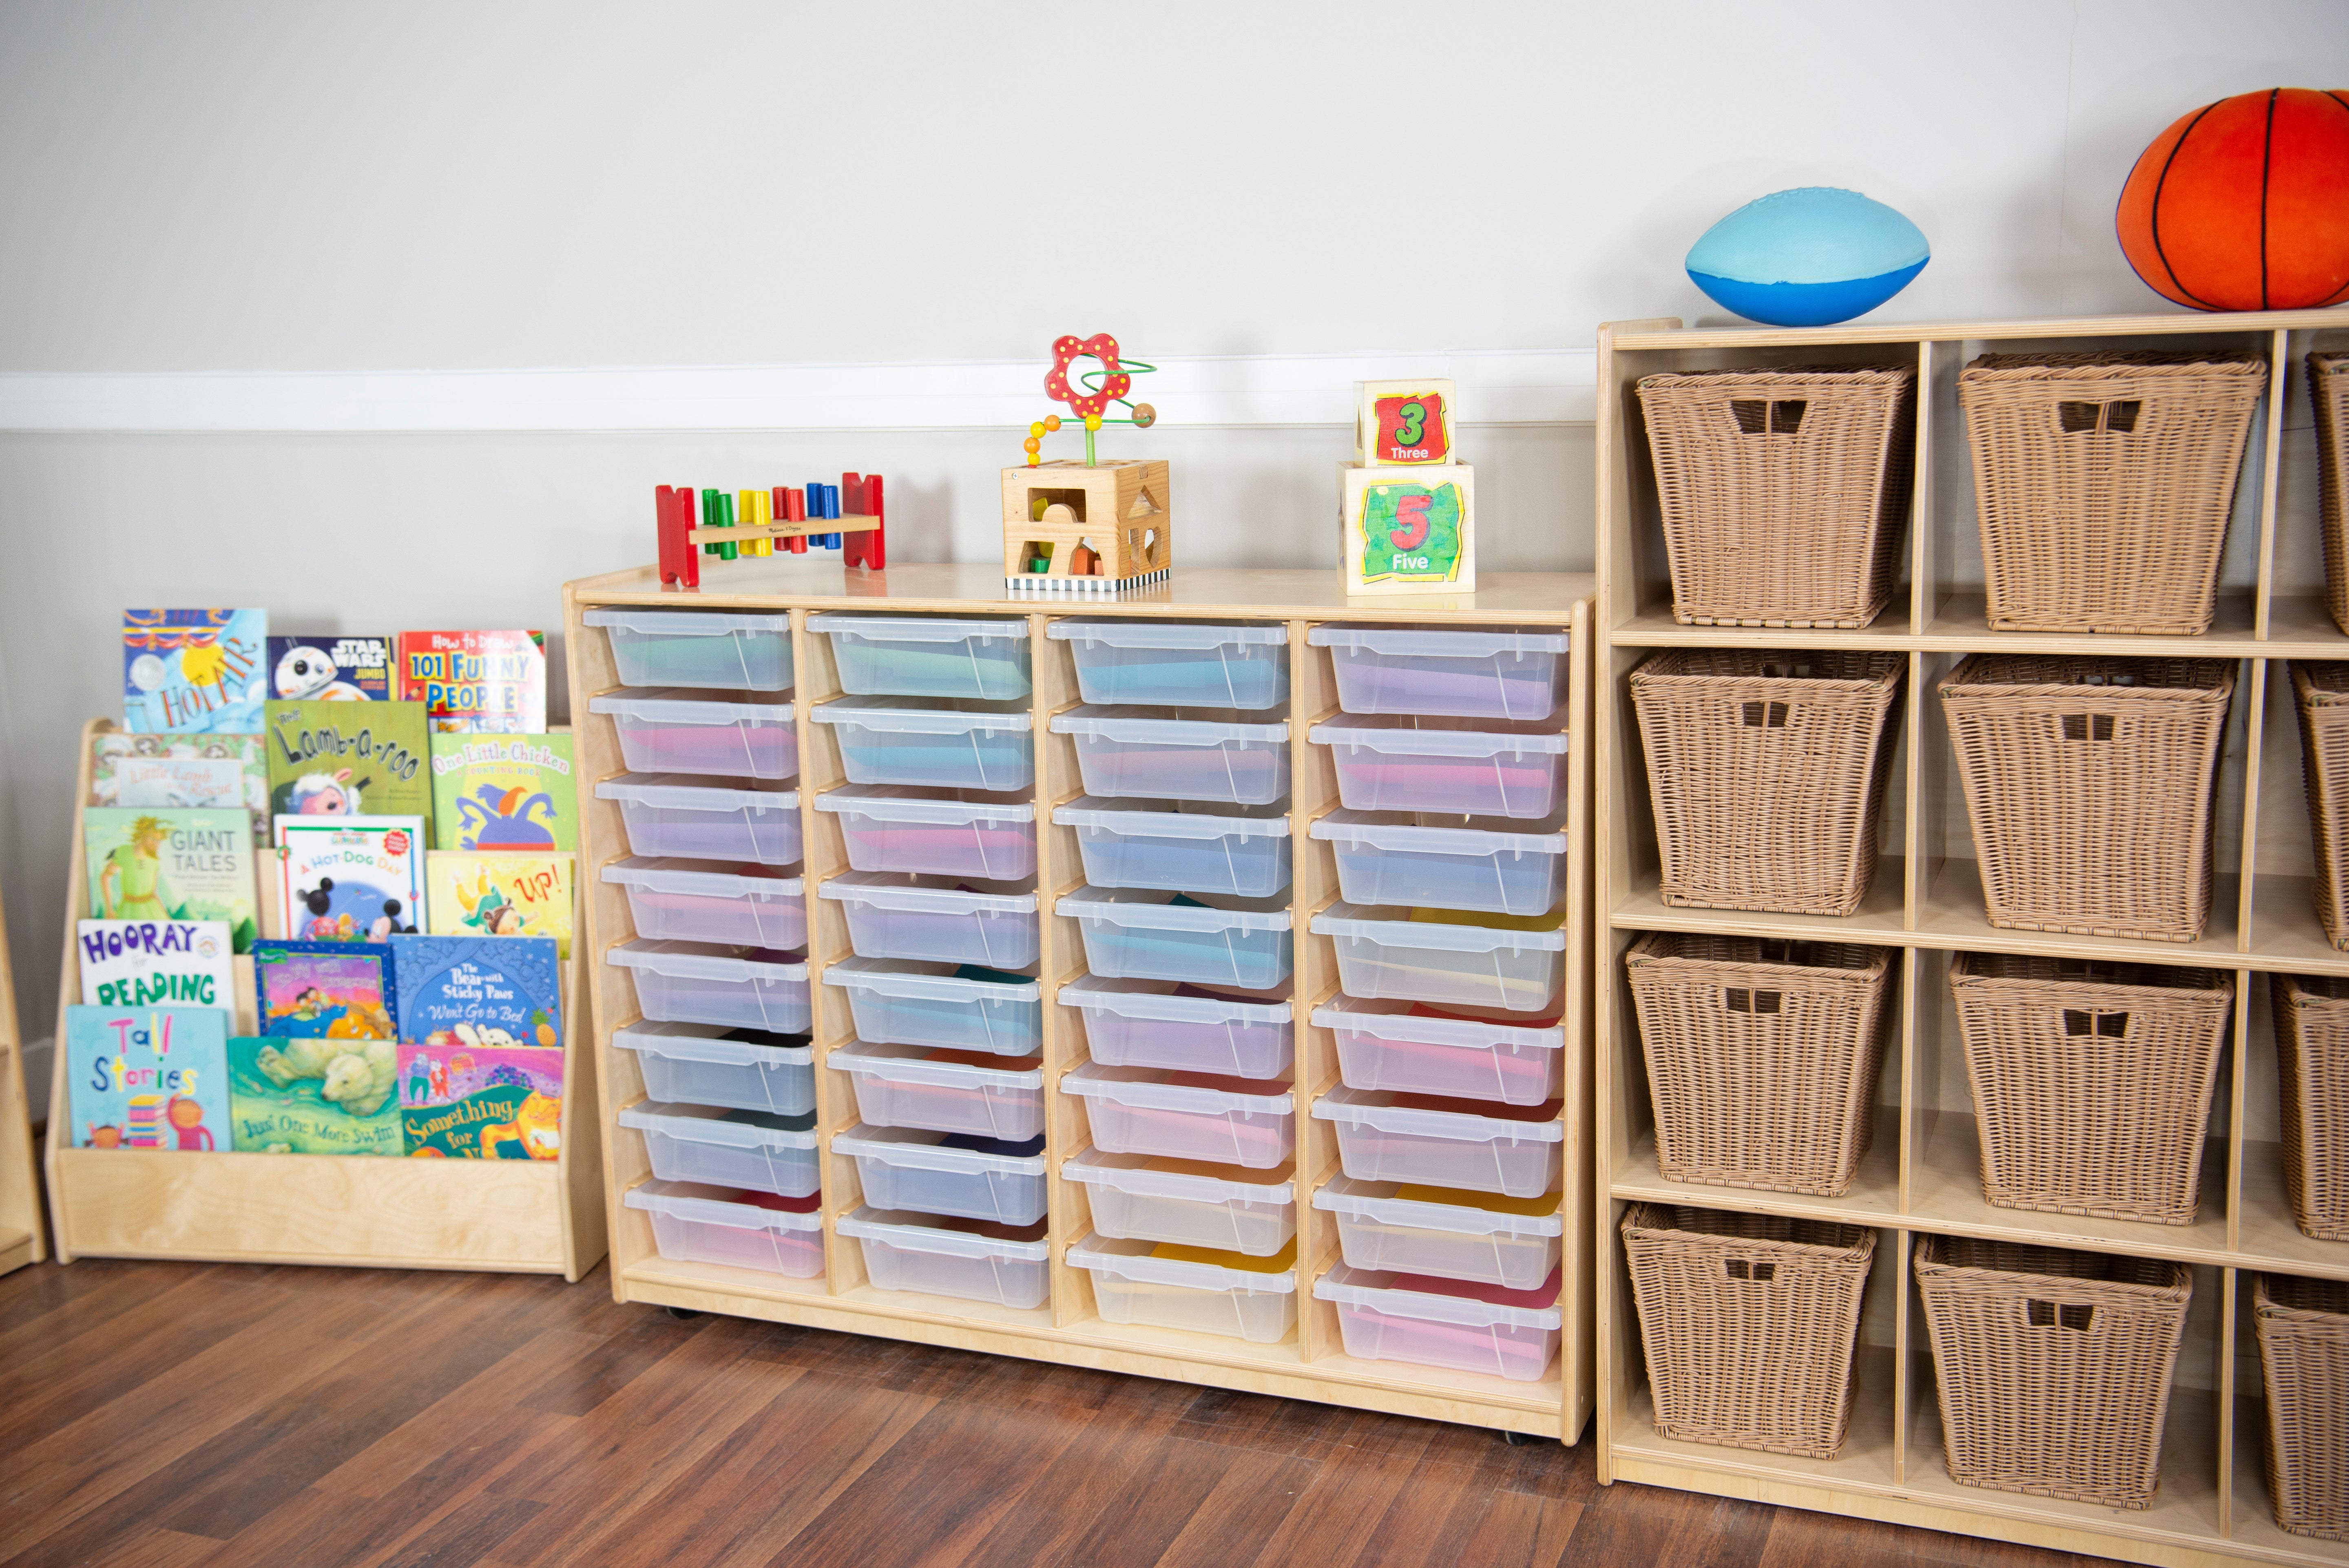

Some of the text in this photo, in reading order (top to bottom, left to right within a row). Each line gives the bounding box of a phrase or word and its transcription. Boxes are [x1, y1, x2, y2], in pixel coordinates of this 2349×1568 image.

[1395, 402, 1427, 447] 3
[1390, 447, 1429, 461] Three
[1390, 495, 1434, 552] 5
[1393, 553, 1429, 570] Five
[330, 639, 386, 654] STAR
[432, 634, 460, 649] How
[462, 633, 476, 650] to
[331, 653, 387, 667] WARS
[410, 652, 530, 680] 101 FUNNY
[160, 637, 258, 728] HOT AIR
[354, 668, 386, 679] JUMBO
[427, 682, 515, 710] PEOPLE
[433, 743, 568, 774] One Little Chicken
[466, 766, 513, 775] COUNTING
[518, 767, 541, 776] BOOK
[170, 830, 235, 851] GIANT
[173, 854, 237, 871] TALES
[301, 865, 310, 875] A
[377, 857, 402, 875] DAY
[83, 923, 197, 963] HOORAY
[450, 968, 482, 985] Bear
[461, 963, 478, 973] The
[98, 972, 215, 1006] READING
[442, 984, 514, 1002] Sticky Paws
[464, 1003, 484, 1026] Go
[486, 1006, 497, 1019] to
[499, 1006, 526, 1024] Bed
[107, 1012, 174, 1055] Tall
[92, 1055, 198, 1096] Stories
[243, 1114, 396, 1144] Just One More Swim
[405, 1099, 513, 1146] Something
[445, 1131, 473, 1149] for
